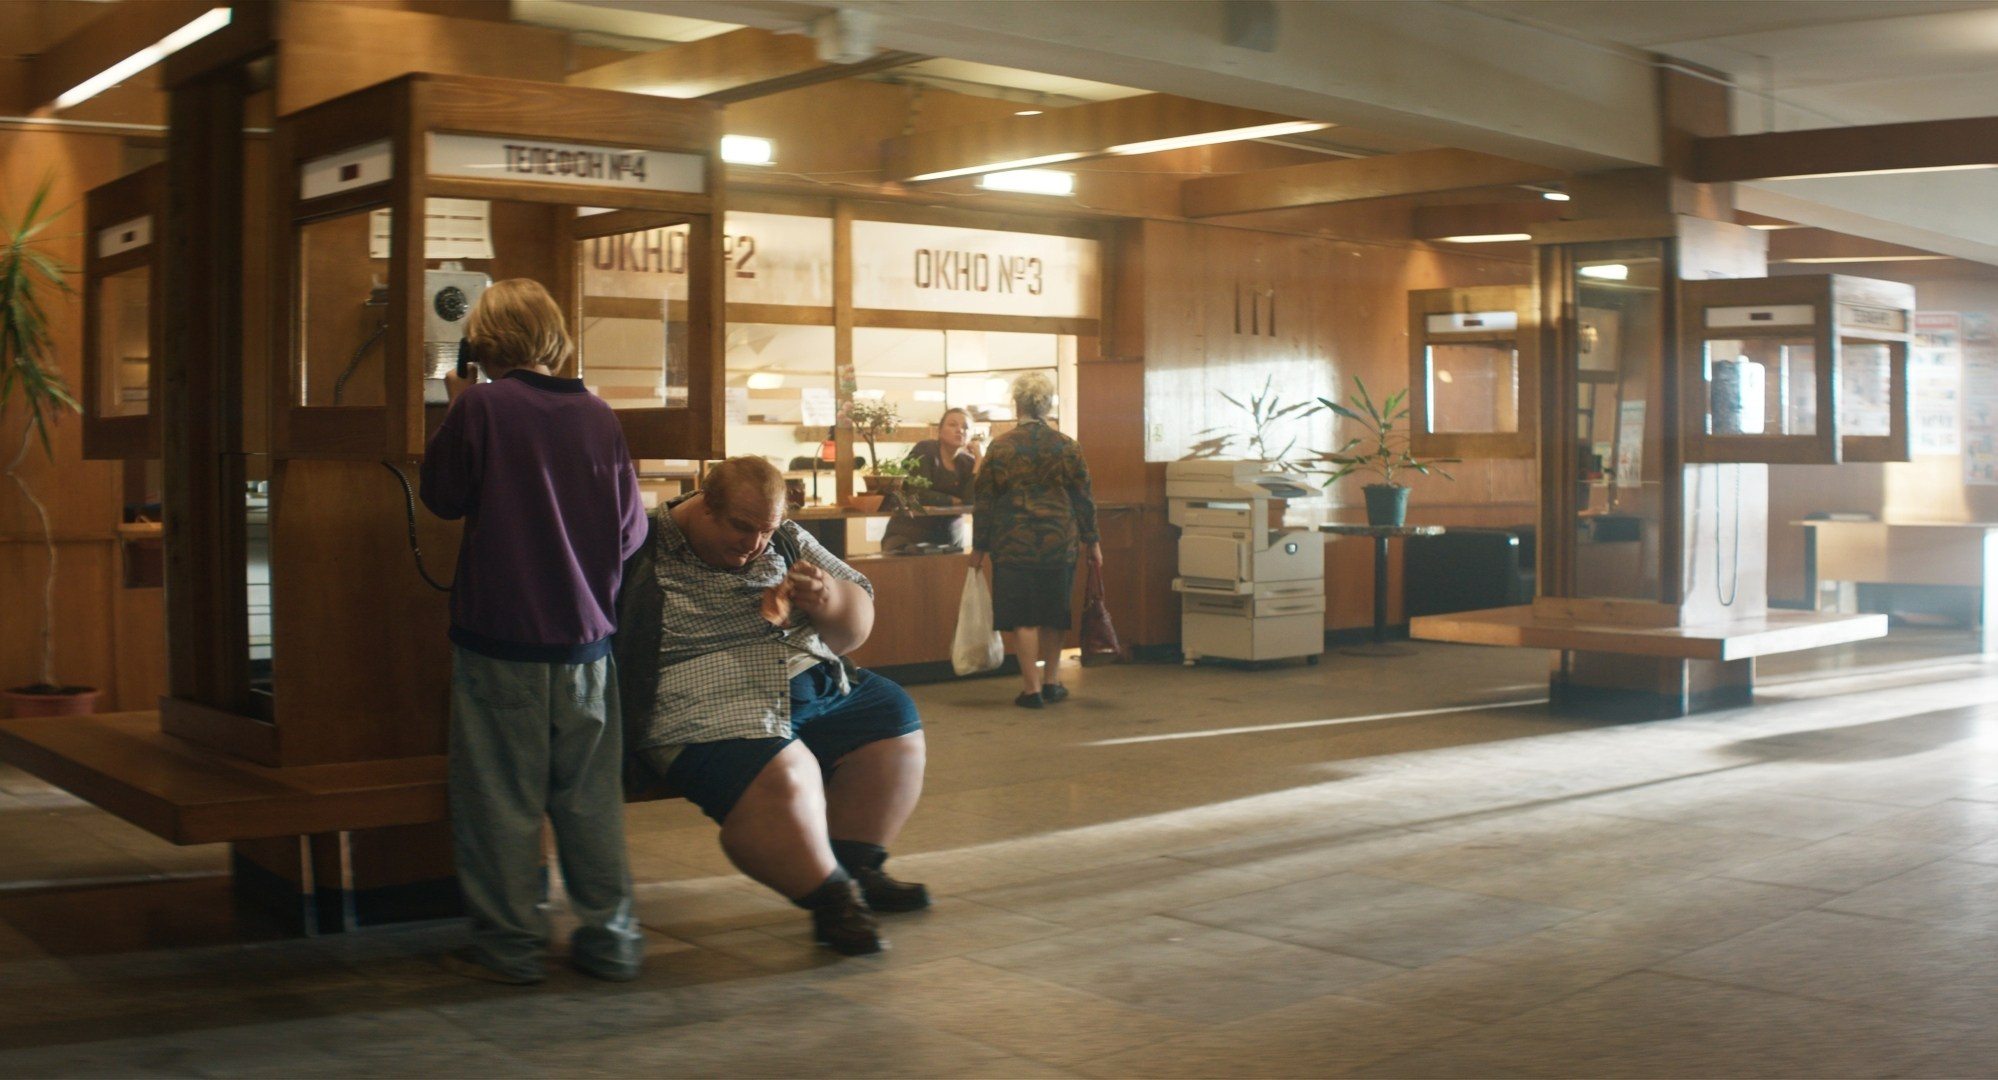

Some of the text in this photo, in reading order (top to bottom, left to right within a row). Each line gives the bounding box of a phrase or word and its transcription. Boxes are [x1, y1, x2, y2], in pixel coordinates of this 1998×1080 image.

[503, 144, 647, 183] ТЕЛЕФОН №4
[594, 230, 689, 274] ОКНО
[915, 248, 1043, 296] ОКНО №3
